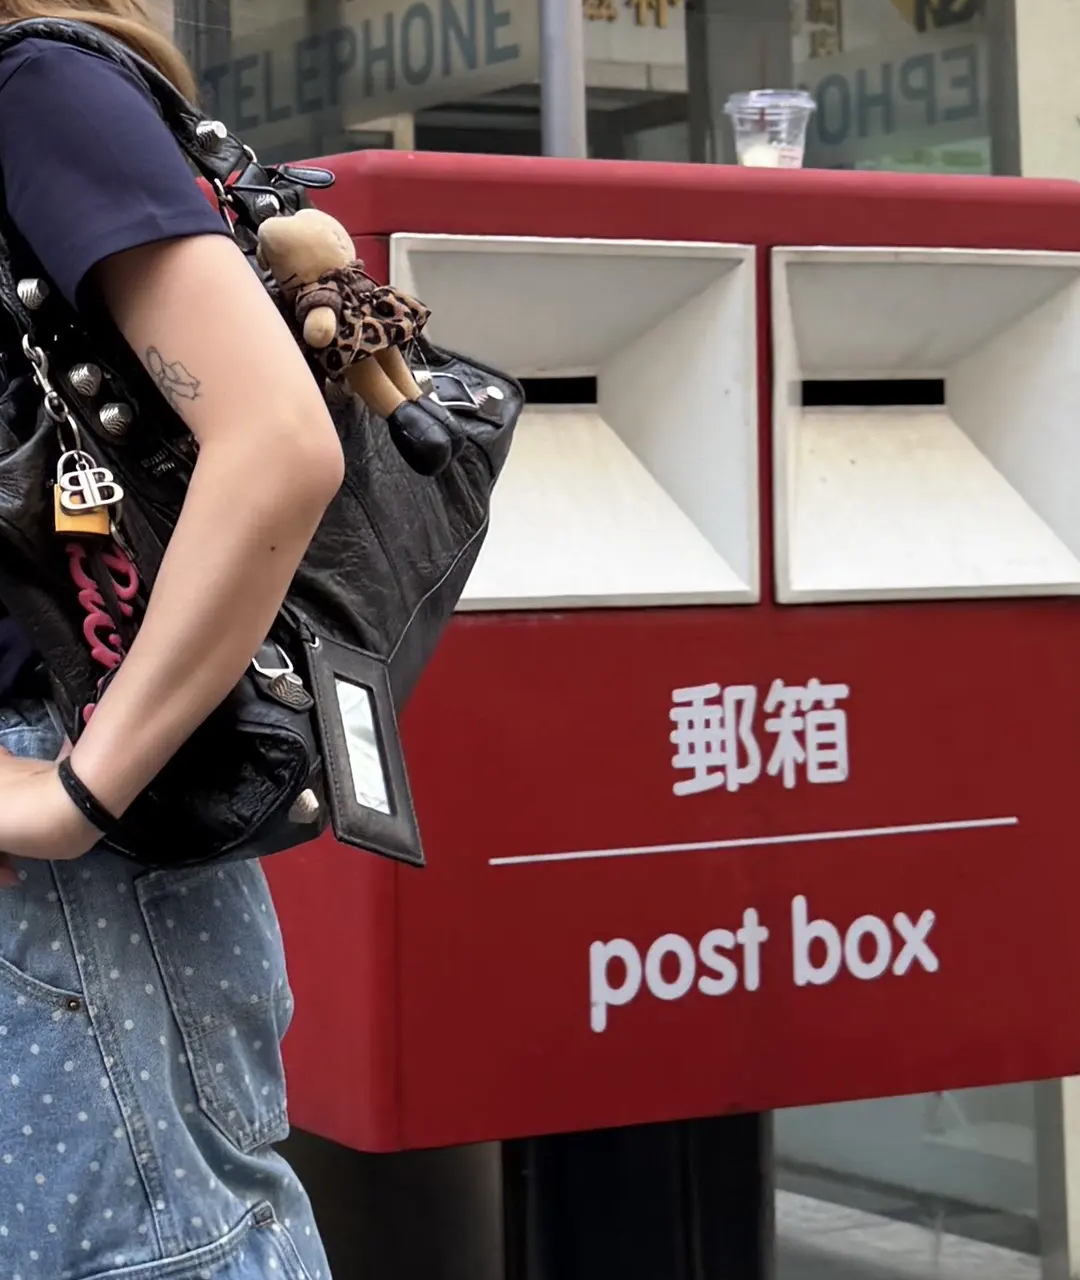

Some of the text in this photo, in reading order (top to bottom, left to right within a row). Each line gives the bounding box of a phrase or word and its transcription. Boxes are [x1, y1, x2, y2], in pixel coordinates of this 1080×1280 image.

[668, 677, 850, 797] 郵箱
[588, 893, 940, 1033] post box
